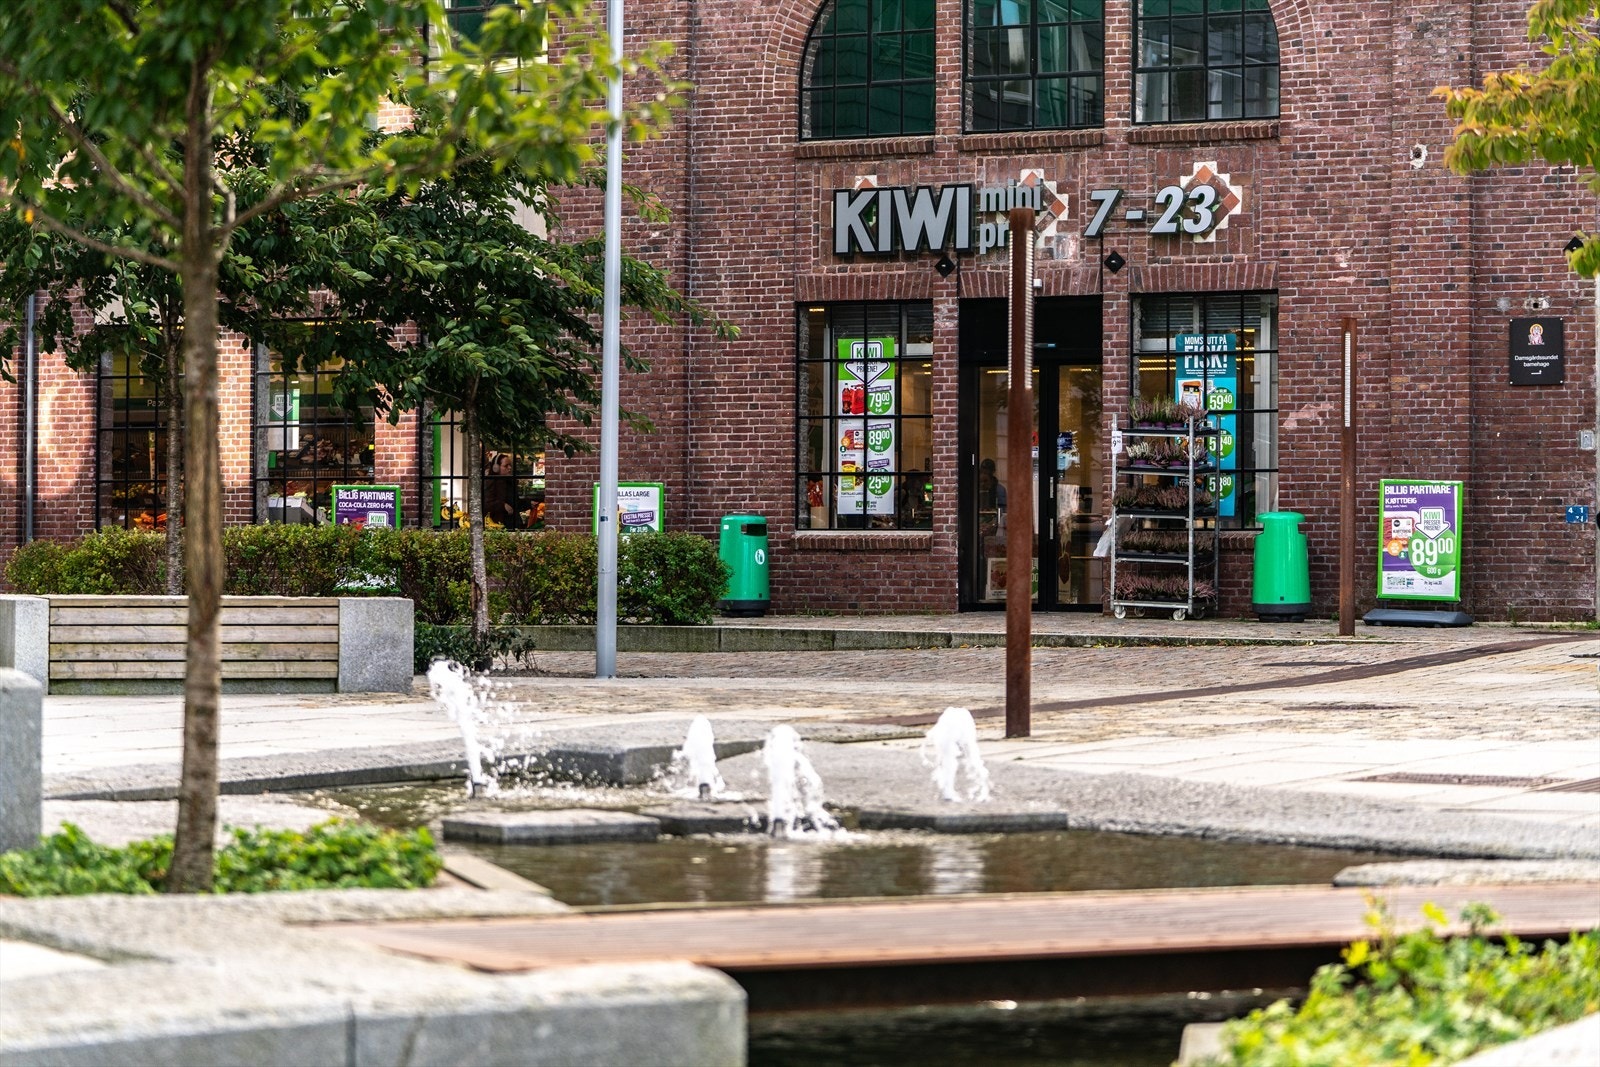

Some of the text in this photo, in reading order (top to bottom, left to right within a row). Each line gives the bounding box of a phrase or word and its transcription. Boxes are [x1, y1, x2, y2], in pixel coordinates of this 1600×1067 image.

[979, 177, 1042, 211] mini
[1083, 188, 1121, 237] 7
[1149, 185, 1218, 235] 23
[834, 185, 973, 255] KIWI
[1184, 334, 1227, 345] MOMSUTT PÅ
[856, 347, 878, 358] KWI
[632, 490, 650, 498] LARGE
[1384, 484, 1451, 495] BILLIG PARTIVARE
[338, 490, 394, 501] BILLIG PARTIVARE
[370, 515, 385, 523] KIWI
[1423, 511, 1441, 520] KIWI
